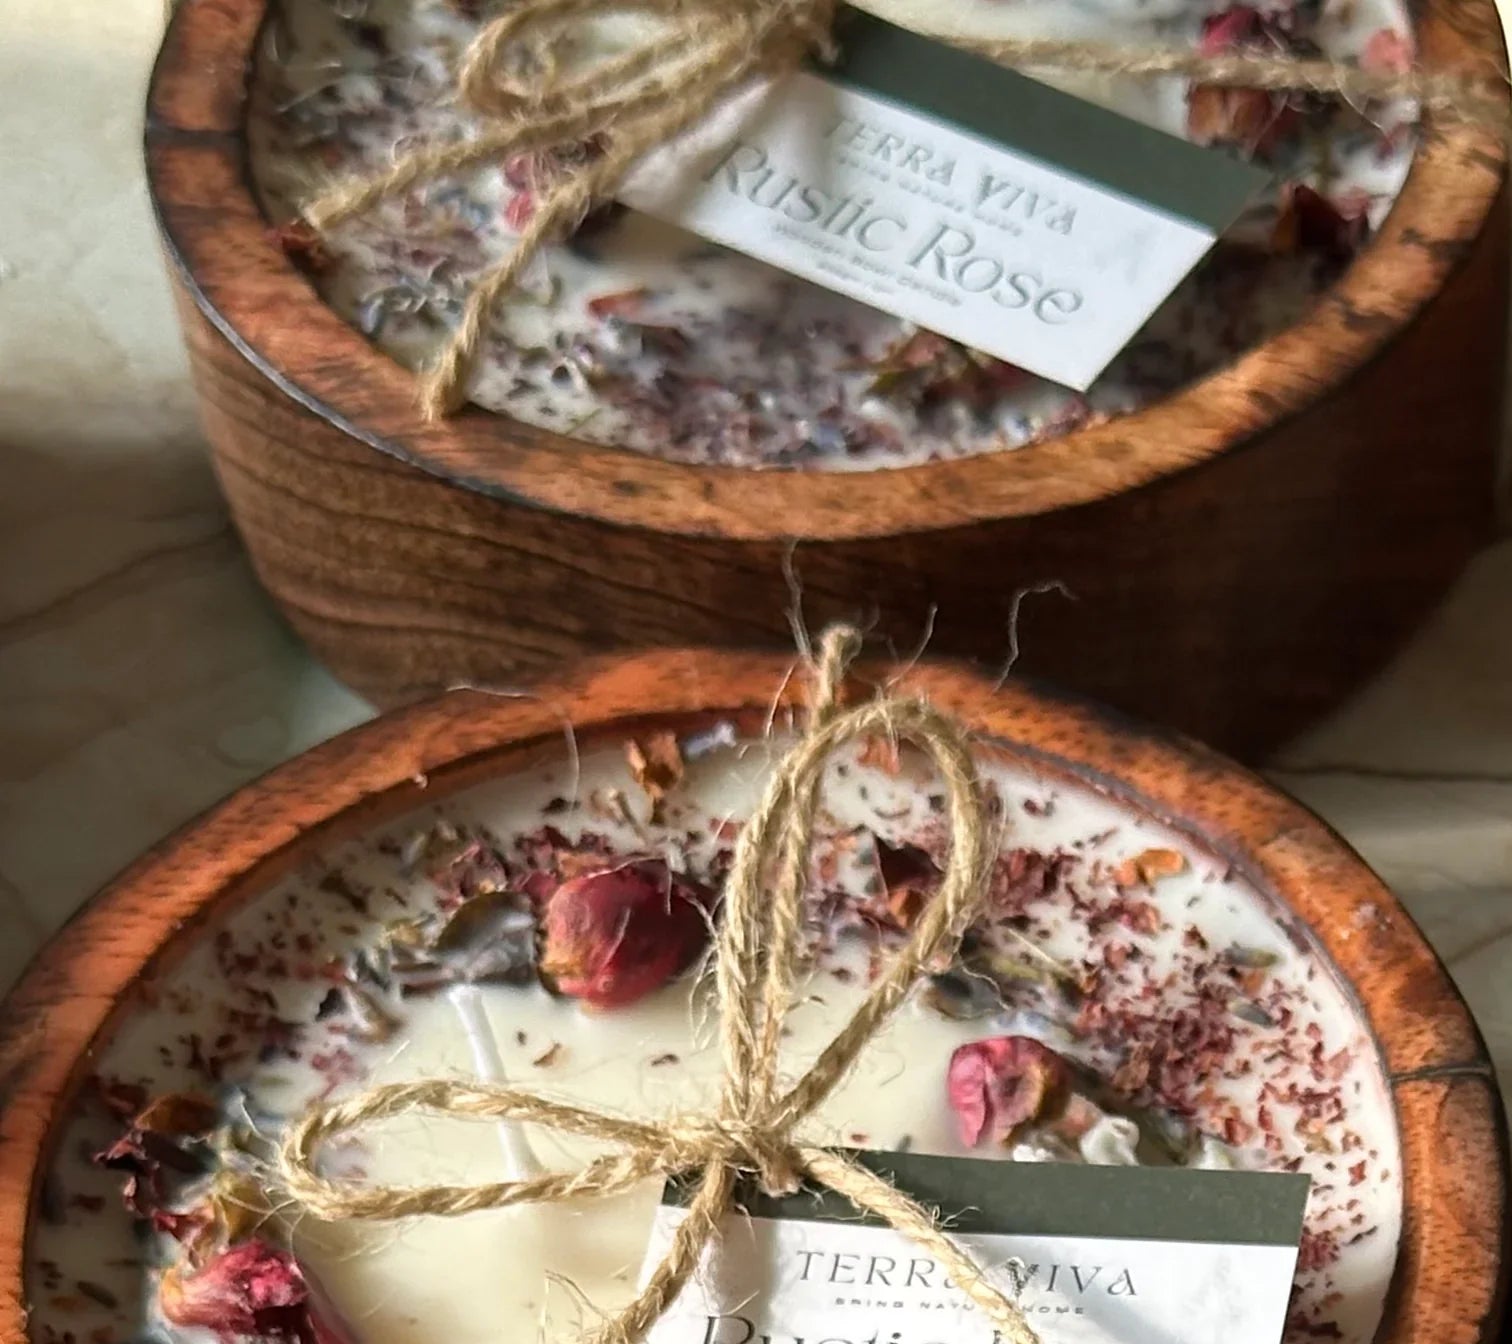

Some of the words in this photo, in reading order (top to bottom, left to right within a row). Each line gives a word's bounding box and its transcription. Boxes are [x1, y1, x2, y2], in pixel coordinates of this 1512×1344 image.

[972, 167, 1077, 236] VIVA
[701, 138, 907, 252] Rustic
[904, 222, 1085, 326] Rose
[796, 1250, 960, 1290] TERR
[1003, 1256, 1140, 1298] VIVA
[920, 1300, 976, 1312] NATU
